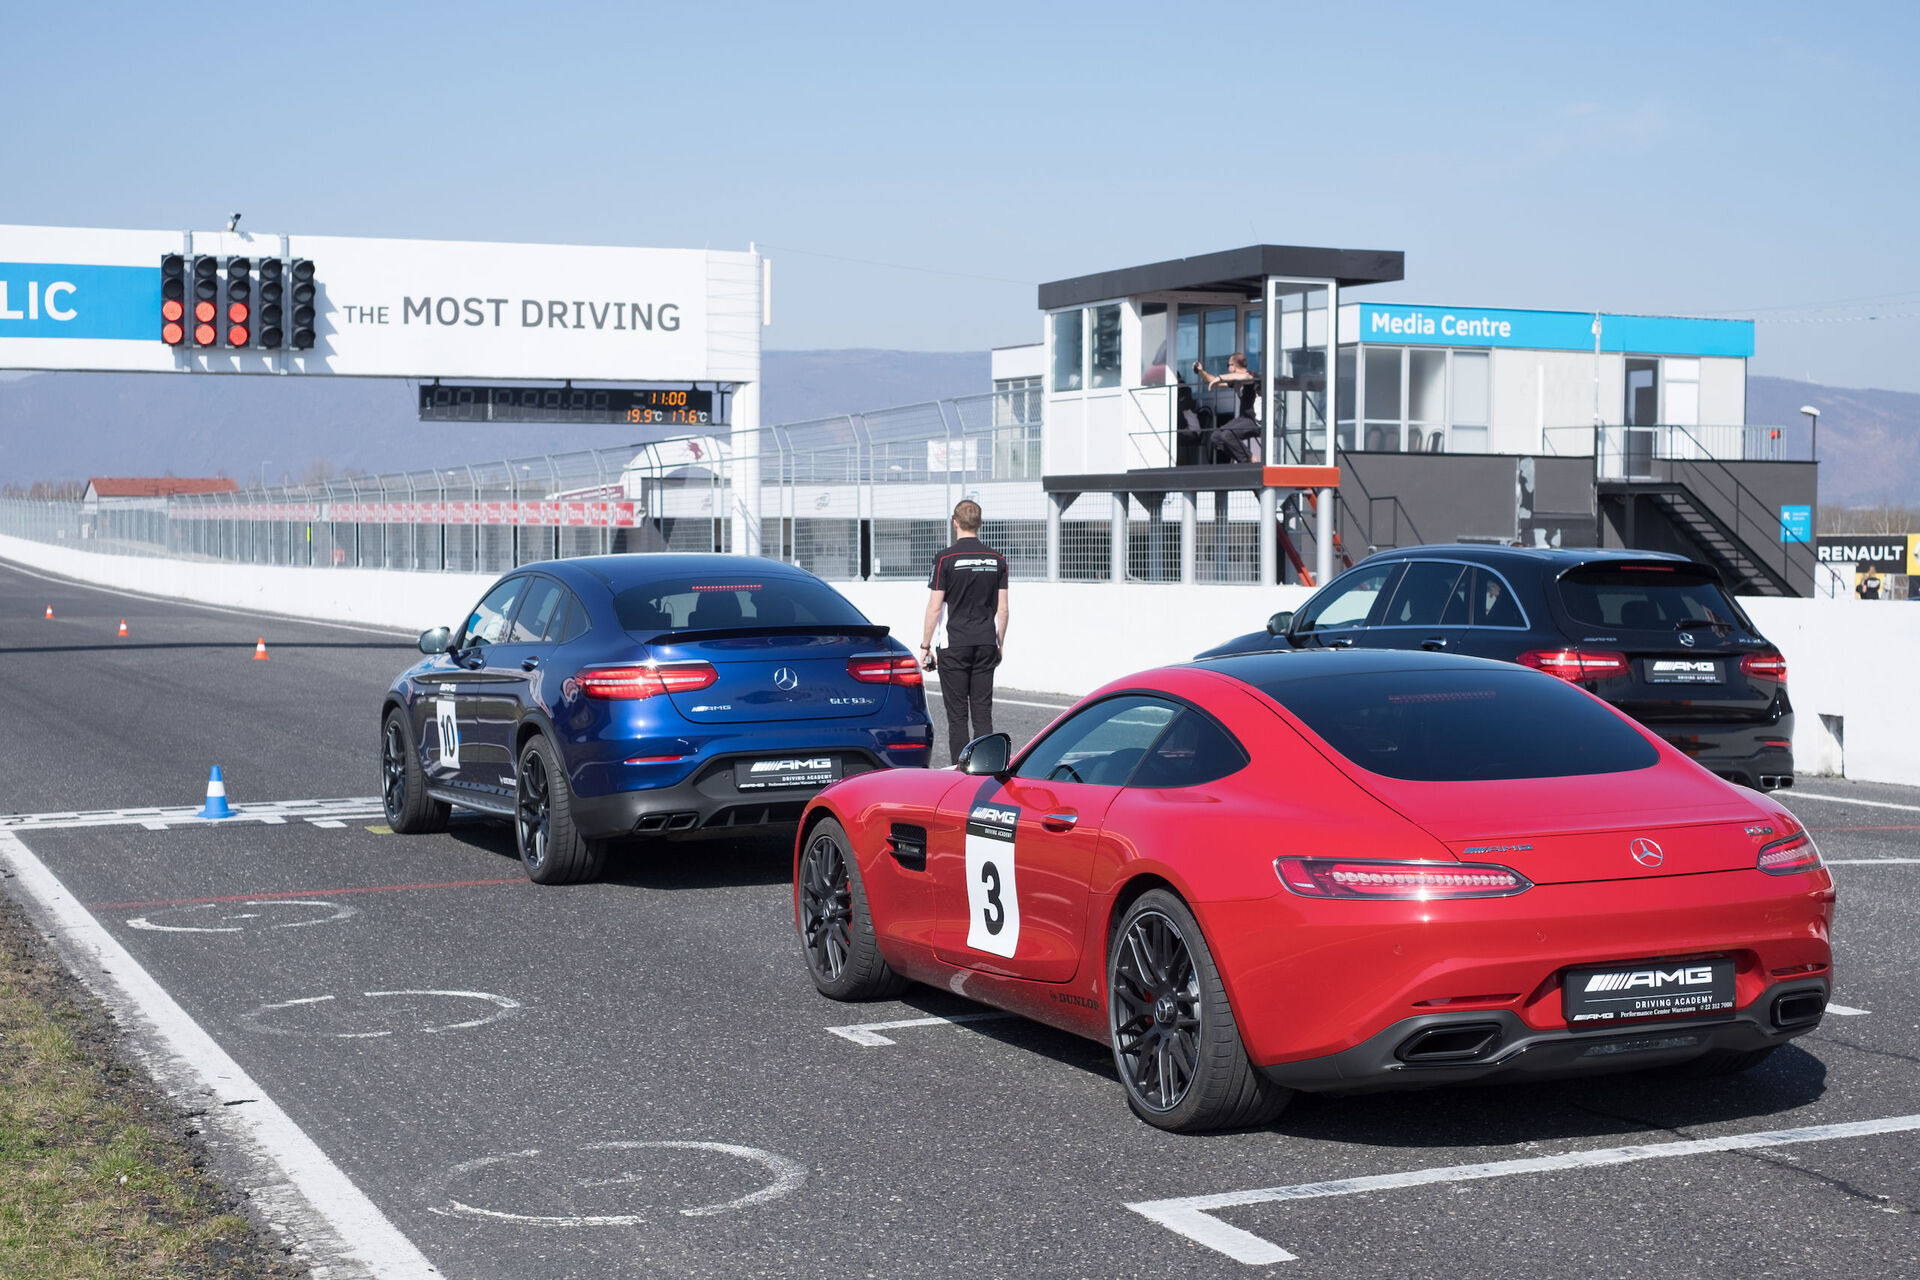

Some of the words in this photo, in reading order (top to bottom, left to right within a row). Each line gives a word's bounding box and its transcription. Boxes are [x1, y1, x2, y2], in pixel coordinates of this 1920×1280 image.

[342, 305, 390, 325] THE
[402, 296, 509, 327] MOST
[521, 299, 681, 332] DRIVING
[1371, 312, 1435, 335] Media
[1441, 315, 1512, 338] Centre
[652, 391, 687, 406] 11:00
[1817, 545, 1904, 561] RENAULT
[1671, 660, 1715, 672] AMG
[829, 697, 850, 705] GLC
[441, 714, 456, 758] 10
[775, 758, 832, 771] AMG
[983, 807, 1017, 825] AMG
[1488, 843, 1533, 853] AMG
[981, 860, 1005, 936] 3
[1623, 966, 1713, 990] AMG
[1058, 992, 1100, 1010] DUNLOP
[1635, 998, 1672, 1010] DRIVING
[1674, 995, 1714, 1007] ACADEMY
[1620, 1009, 1653, 1018] Performance
[1653, 1007, 1671, 1016] Center
